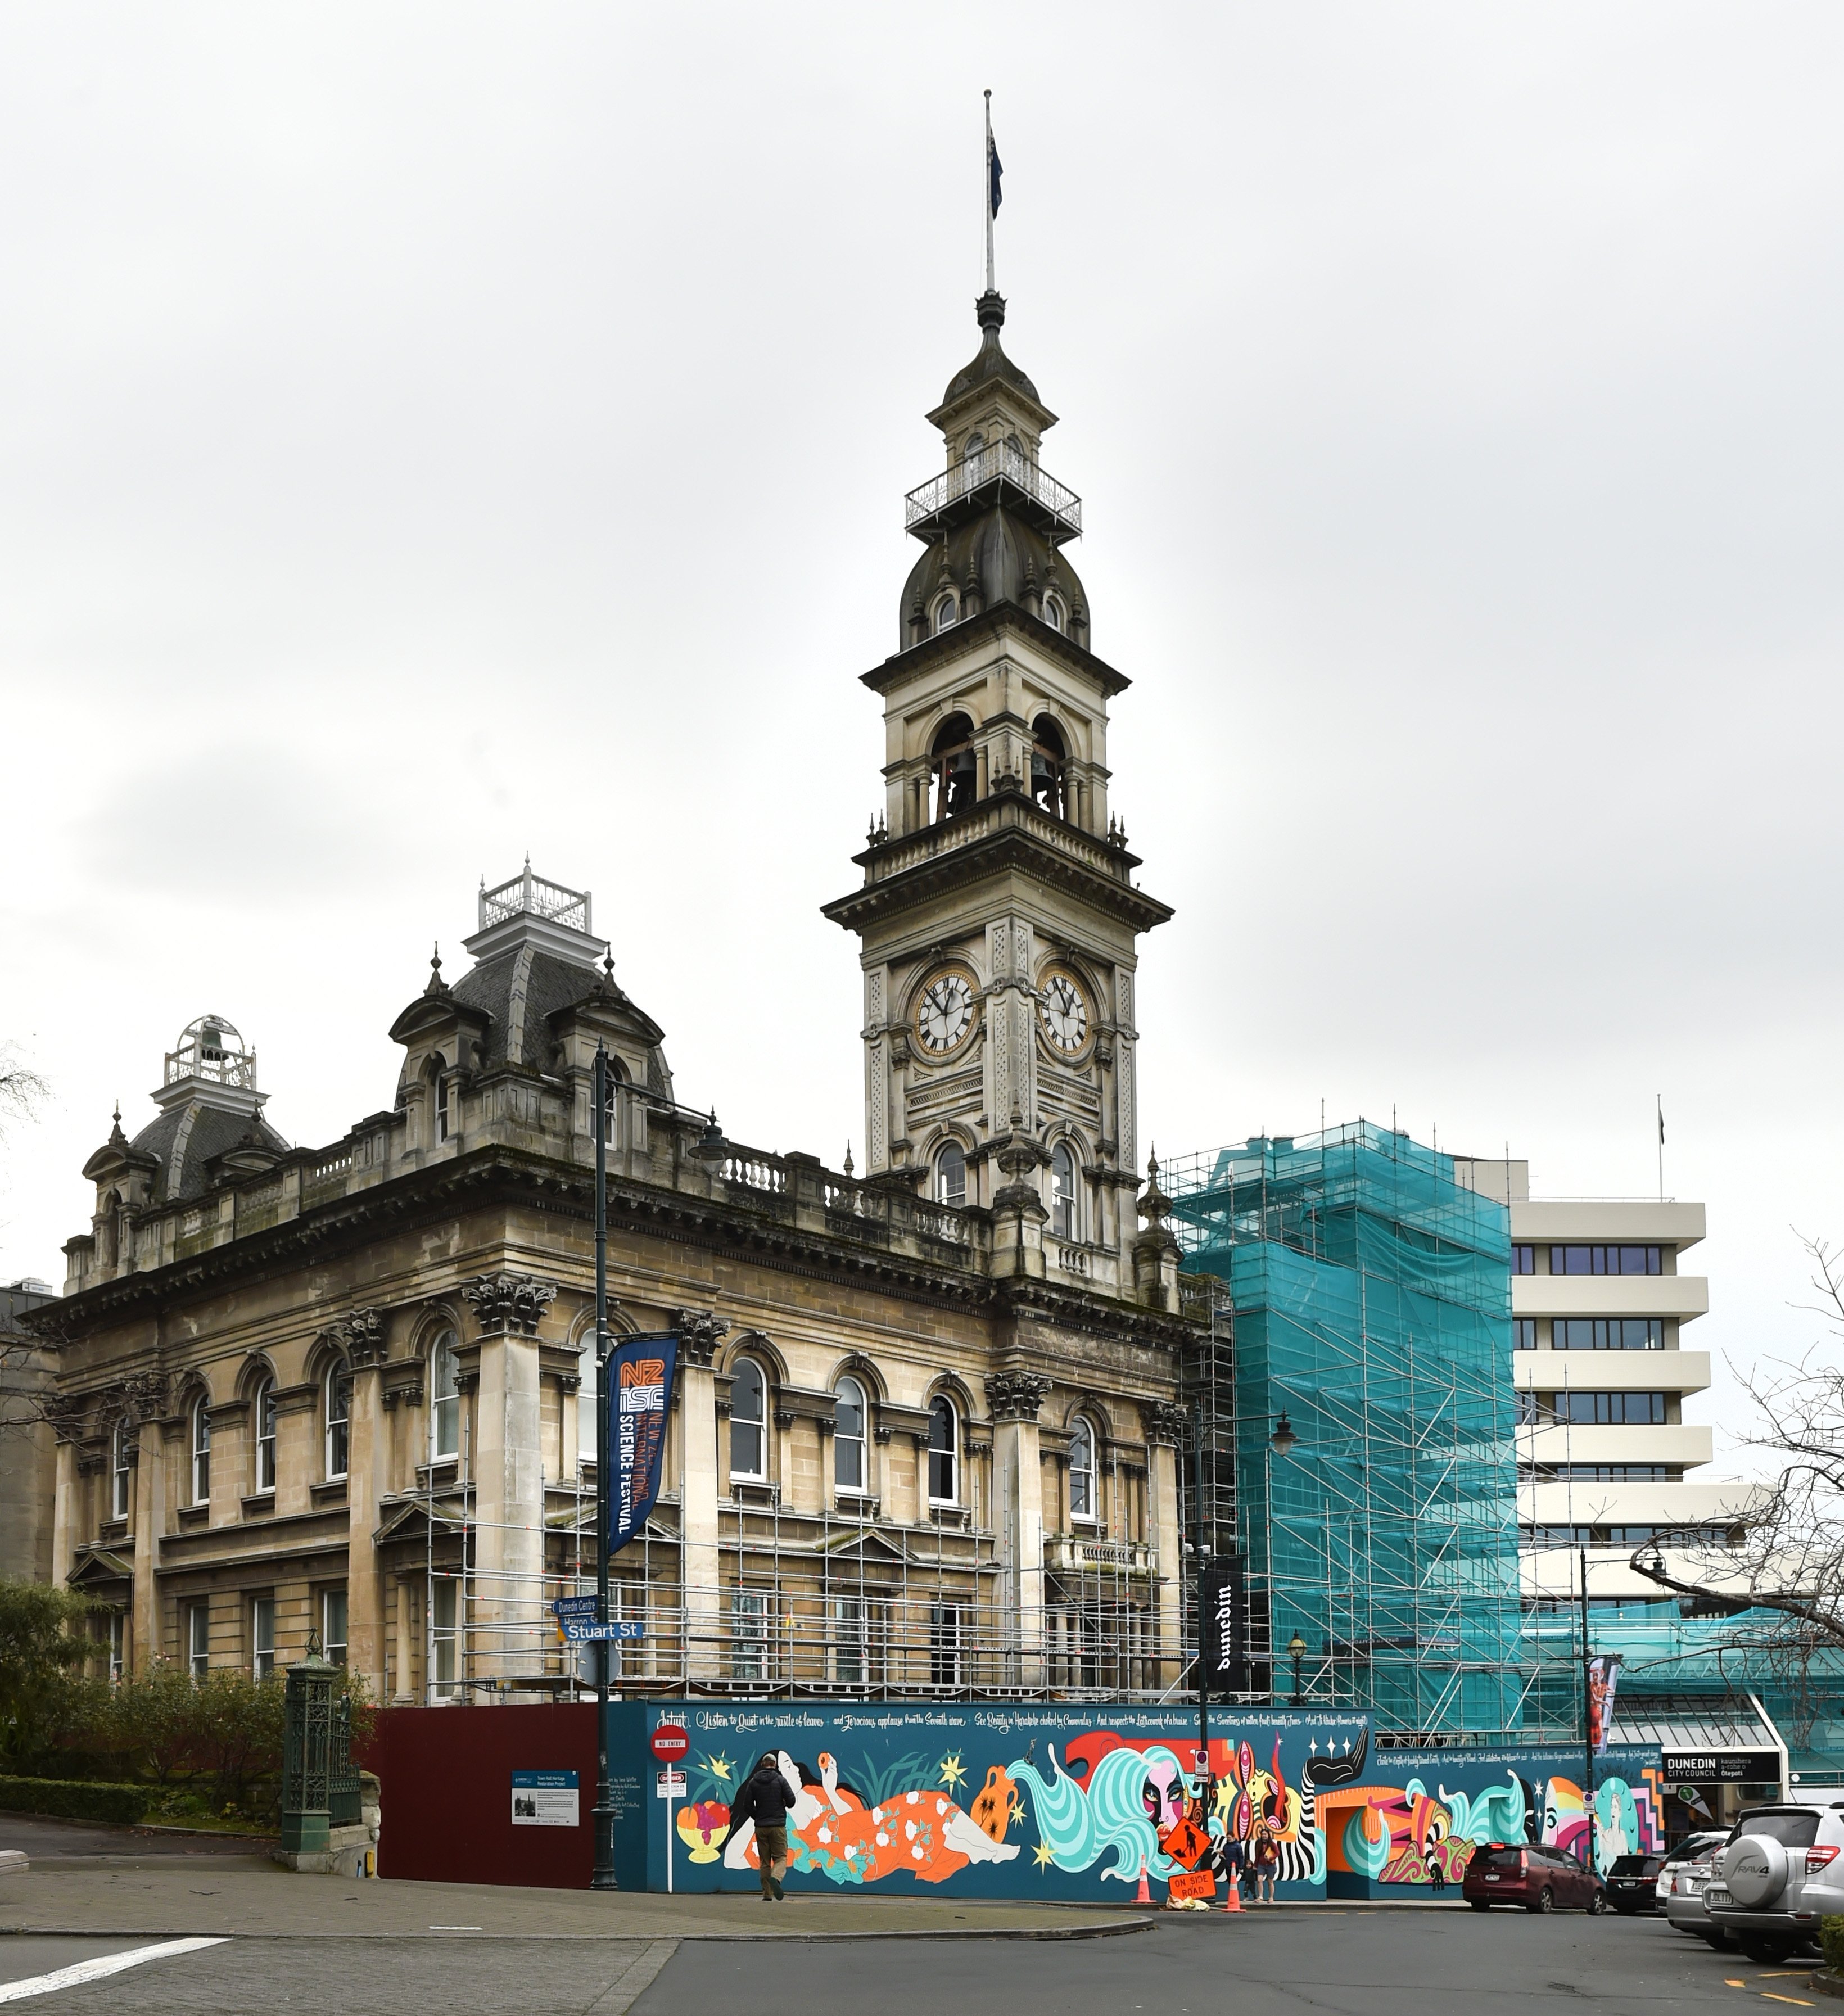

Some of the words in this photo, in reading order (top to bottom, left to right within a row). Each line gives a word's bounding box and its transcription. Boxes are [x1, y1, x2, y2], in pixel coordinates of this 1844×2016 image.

[648, 1413, 663, 1441] NEW
[620, 1415, 635, 1470] SCIENCE
[632, 1413, 648, 1511] INTERNATIONAL
[618, 1474, 631, 1534] FESTIVAL
[559, 1601, 578, 1613] Dunedin
[578, 1599, 595, 1611] Centre
[590, 1616, 598, 1624] St
[568, 1624, 615, 1639] Stuart
[620, 1623, 637, 1637] St
[696, 1711, 729, 1730] Listen
[729, 1713, 738, 1725] to
[735, 1713, 758, 1733] Quiet
[759, 1716, 765, 1725] in
[765, 1714, 774, 1725] the
[774, 1713, 795, 1727] rustle
[796, 1715, 802, 1727] of
[803, 1711, 824, 1727] leaves
[833, 1714, 843, 1725] and
[841, 1715, 875, 1732] Ferocious
[878, 1713, 903, 1729] applause
[905, 1714, 916, 1724] from
[914, 1714, 924, 1724] the
[925, 1712, 947, 1725] Seventh
[948, 1716, 966, 1727] wave
[974, 1712, 986, 1725] See
[987, 1712, 1010, 1734] Beauty
[1008, 1716, 1014, 1725] in
[1013, 1711, 1038, 1731] Harakeke
[1040, 1712, 1057, 1725] choked
[1057, 1714, 1065, 1730] by
[1097, 1713, 1107, 1726] And
[1108, 1714, 1128, 1728] respect
[1136, 1713, 1165, 1730] Latticework
[1164, 1714, 1170, 1726] of
[1173, 1714, 1188, 1725] bruise
[1217, 1714, 1240, 1726] Sweetness
[1667, 1759, 1716, 1769] DUNEDIN
[1738, 1866, 1769, 1874] RAV4
[1174, 1878, 1186, 1887] ON
[1190, 1875, 1208, 1885] SIDE
[1182, 1886, 1204, 1897] ROAD
